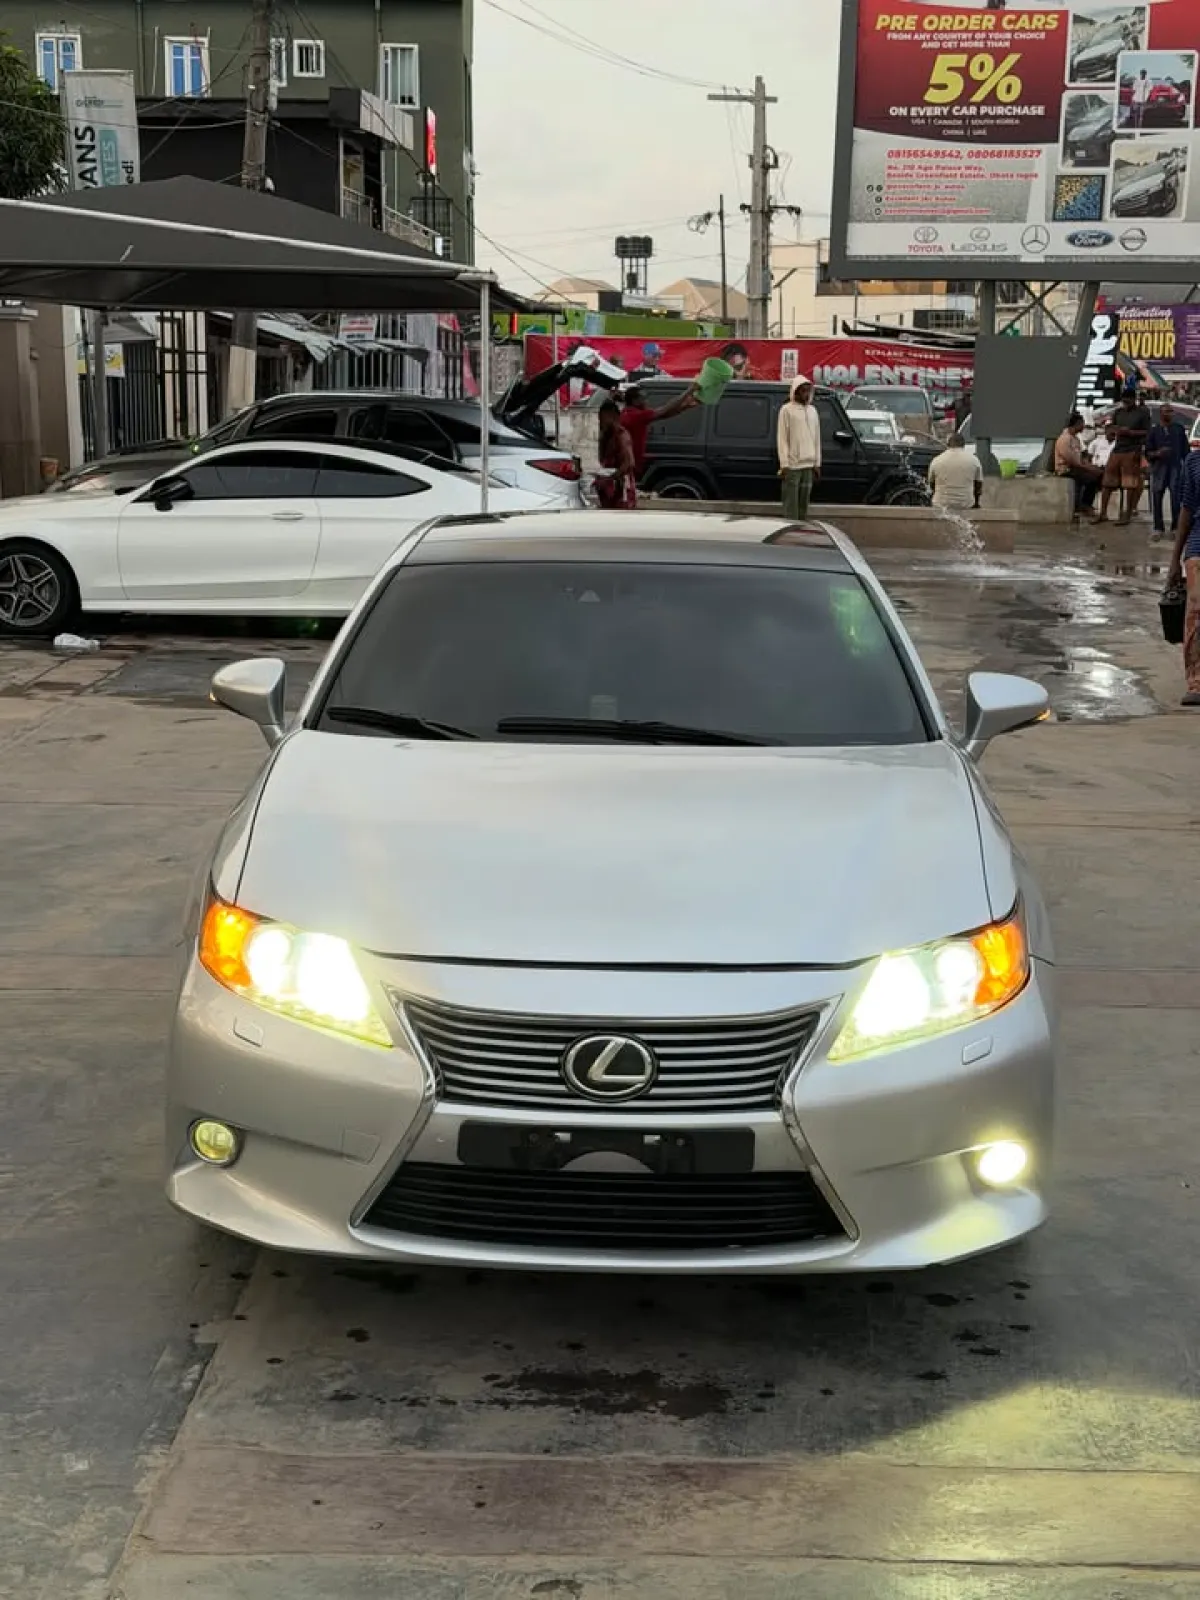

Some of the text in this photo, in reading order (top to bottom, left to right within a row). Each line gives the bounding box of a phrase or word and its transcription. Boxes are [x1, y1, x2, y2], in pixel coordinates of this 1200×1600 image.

[875, 14, 1059, 30] PRE ORDER CARS
[887, 32, 911, 40] FROM
[913, 32, 930, 40] ANY
[933, 32, 973, 40] COUNTRY
[921, 41, 941, 49] AND
[923, 53, 1023, 104] 5%
[889, 106, 1045, 116] ON EVERY CAR PURCHASE
[75, 125, 98, 190] ANS
[101, 139, 118, 185] ATES
[908, 244, 944, 253] TOYOTA
[1120, 332, 1175, 359] AVOUR
